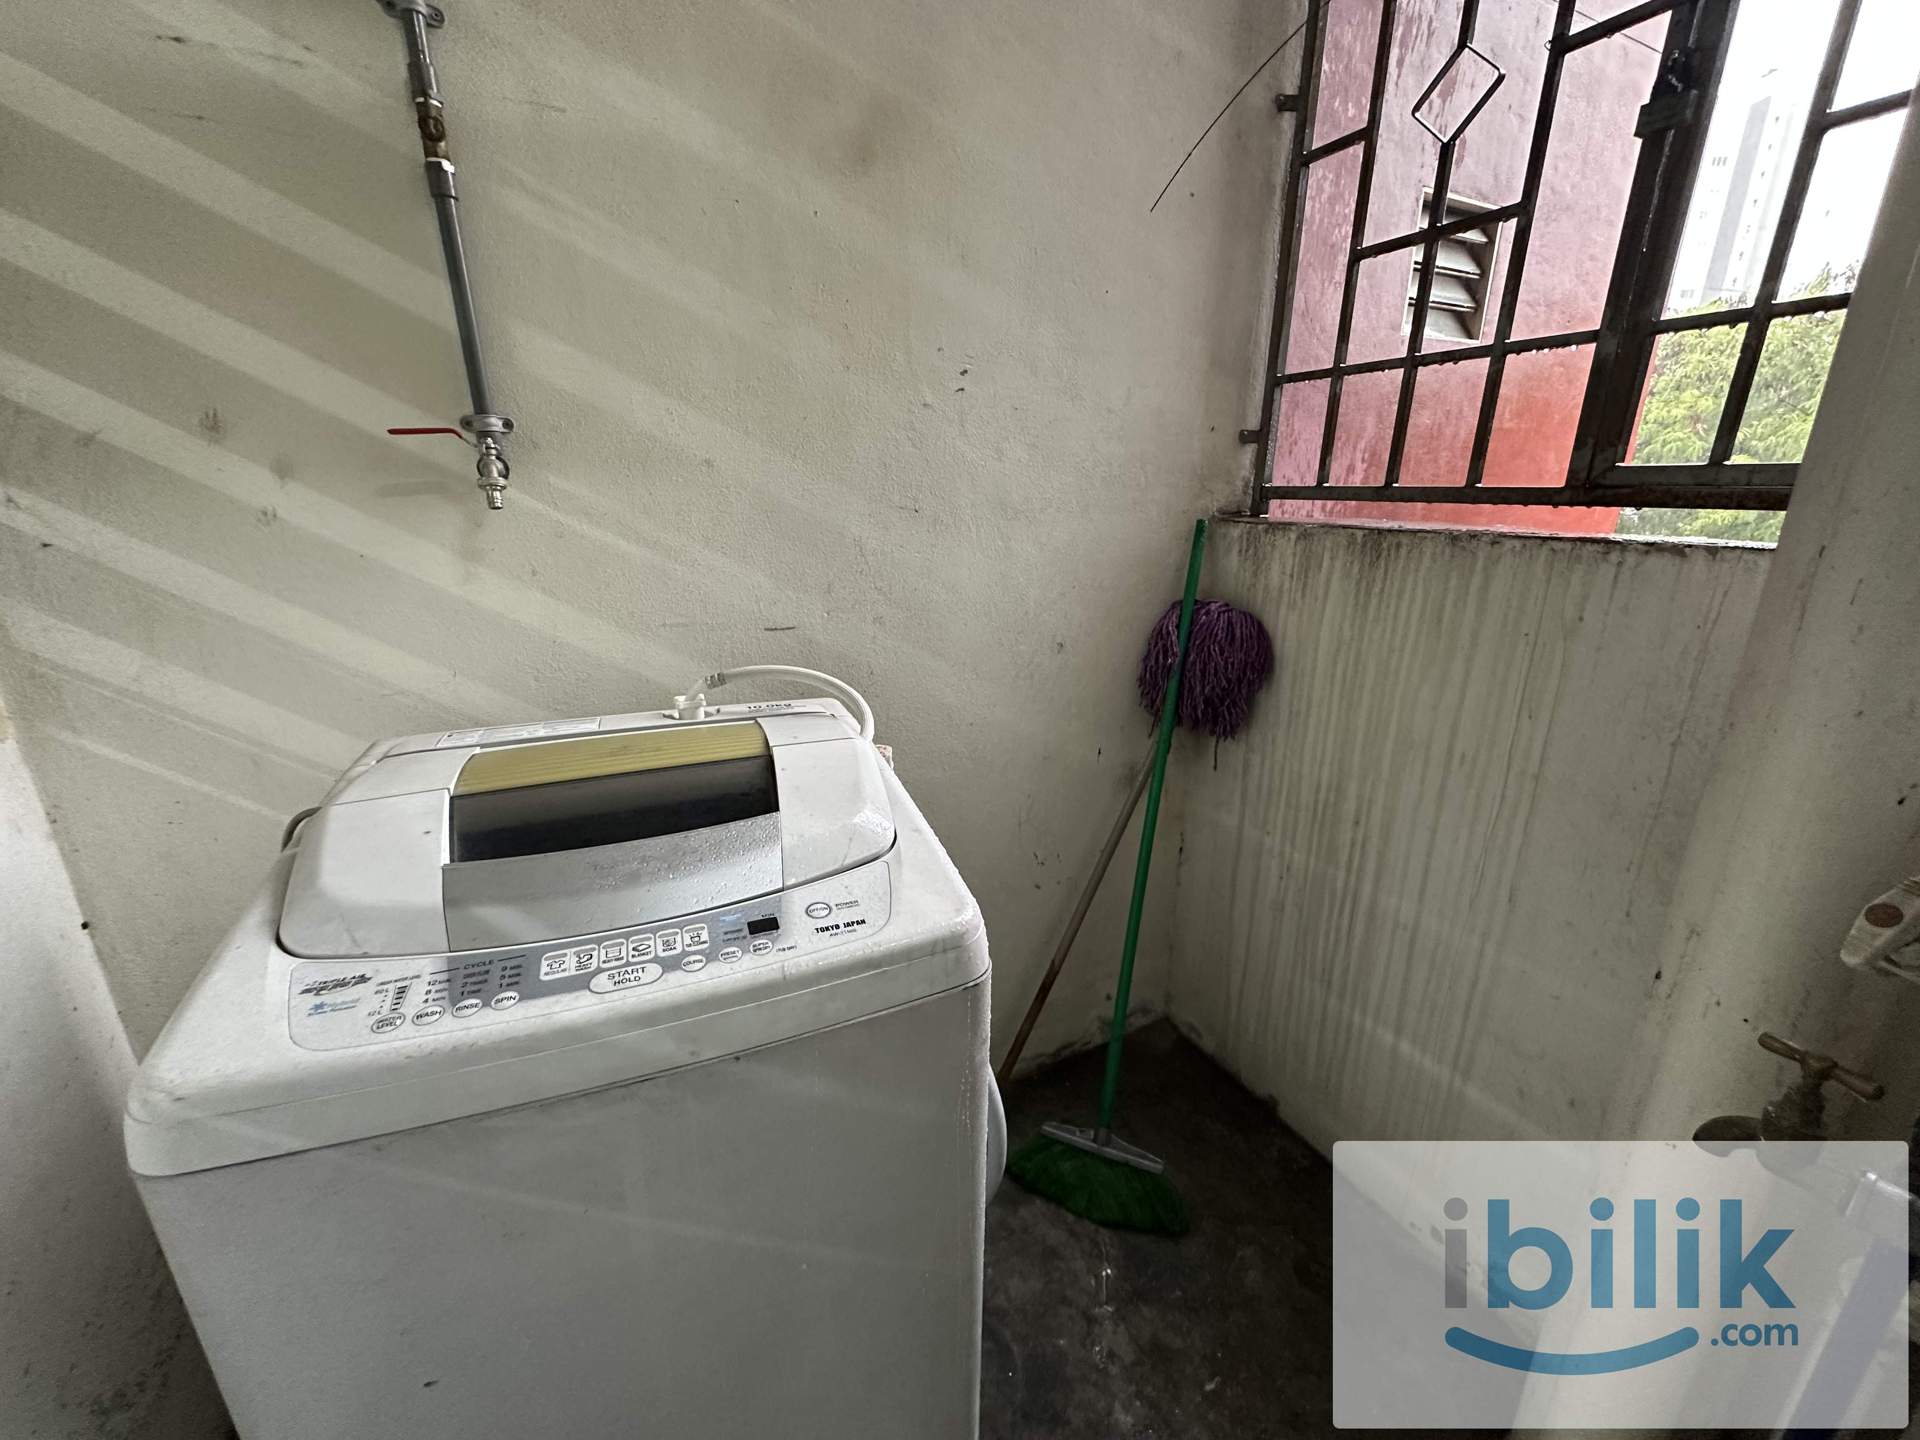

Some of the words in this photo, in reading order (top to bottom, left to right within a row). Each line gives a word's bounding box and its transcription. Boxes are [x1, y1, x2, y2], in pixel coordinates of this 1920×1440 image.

[814, 924, 840, 934] TOKYO
[843, 918, 867, 928] JAPAN
[631, 951, 652, 959] BLANKET
[463, 960, 494, 970] CYCLE
[682, 958, 704, 967] COURSE
[608, 966, 647, 980] START
[613, 975, 641, 987] HOLD
[494, 995, 517, 1005] SPIN
[455, 1002, 480, 1013] RINSE
[415, 1010, 442, 1020] WASH
